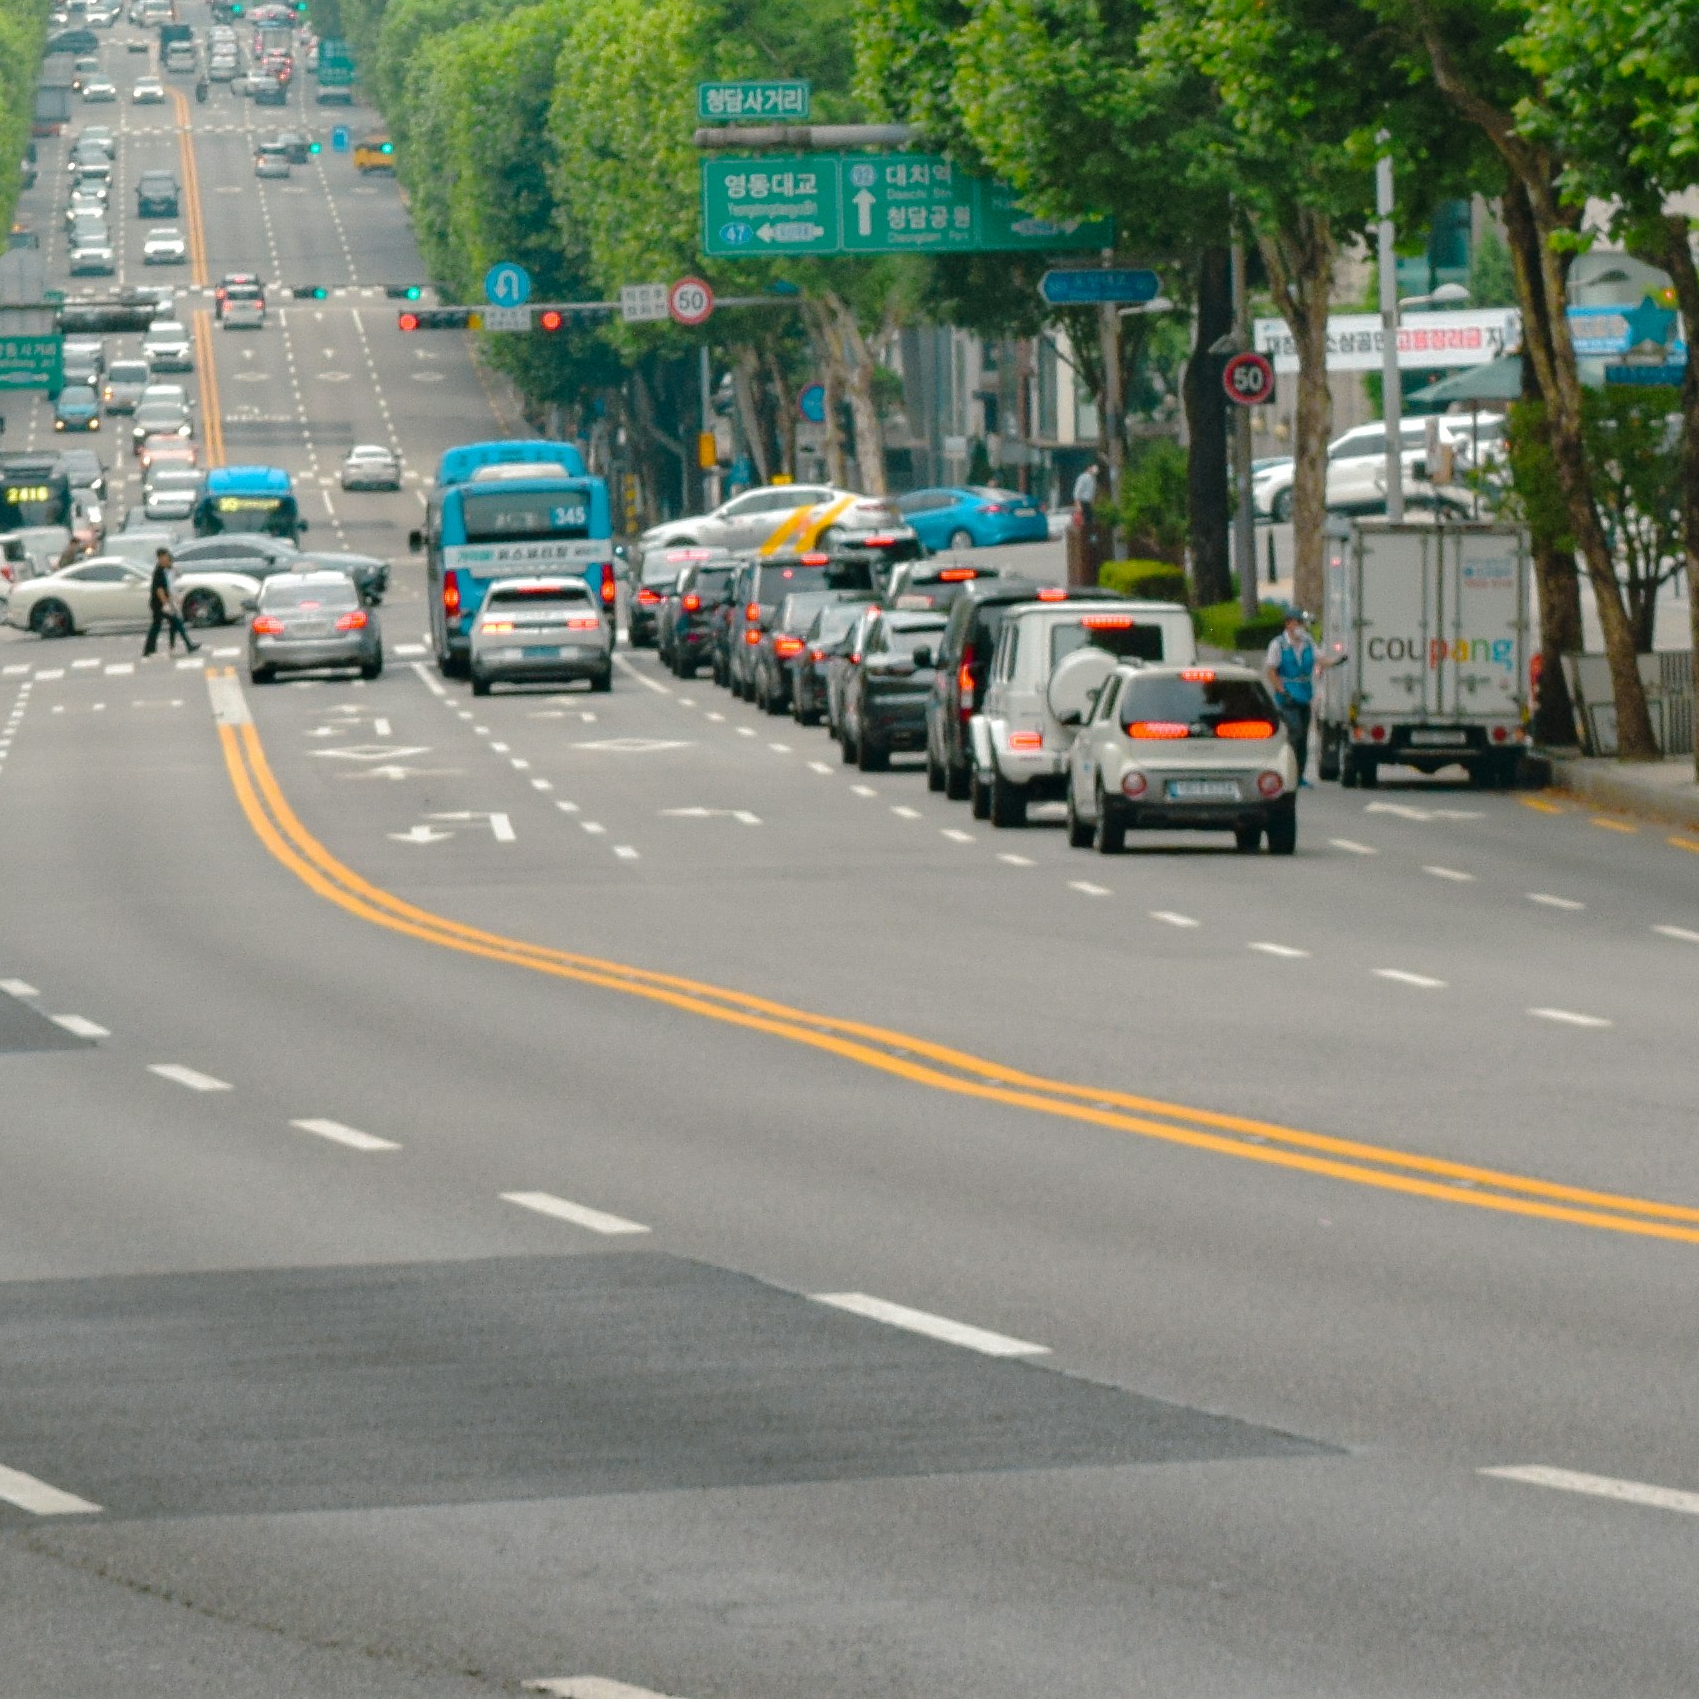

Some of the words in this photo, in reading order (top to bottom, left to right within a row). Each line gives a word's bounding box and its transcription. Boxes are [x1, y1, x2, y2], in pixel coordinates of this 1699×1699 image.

[707, 88, 801, 113] 청담사거리
[725, 172, 817, 199] 영동대교
[885, 164, 951, 188] 대치역
[888, 205, 970, 229] 청담공원
[726, 225, 744, 241] 47
[679, 290, 704, 311] 50
[1234, 366, 1263, 391] 50
[556, 507, 585, 525] 345
[1368, 637, 1515, 672] coupang
